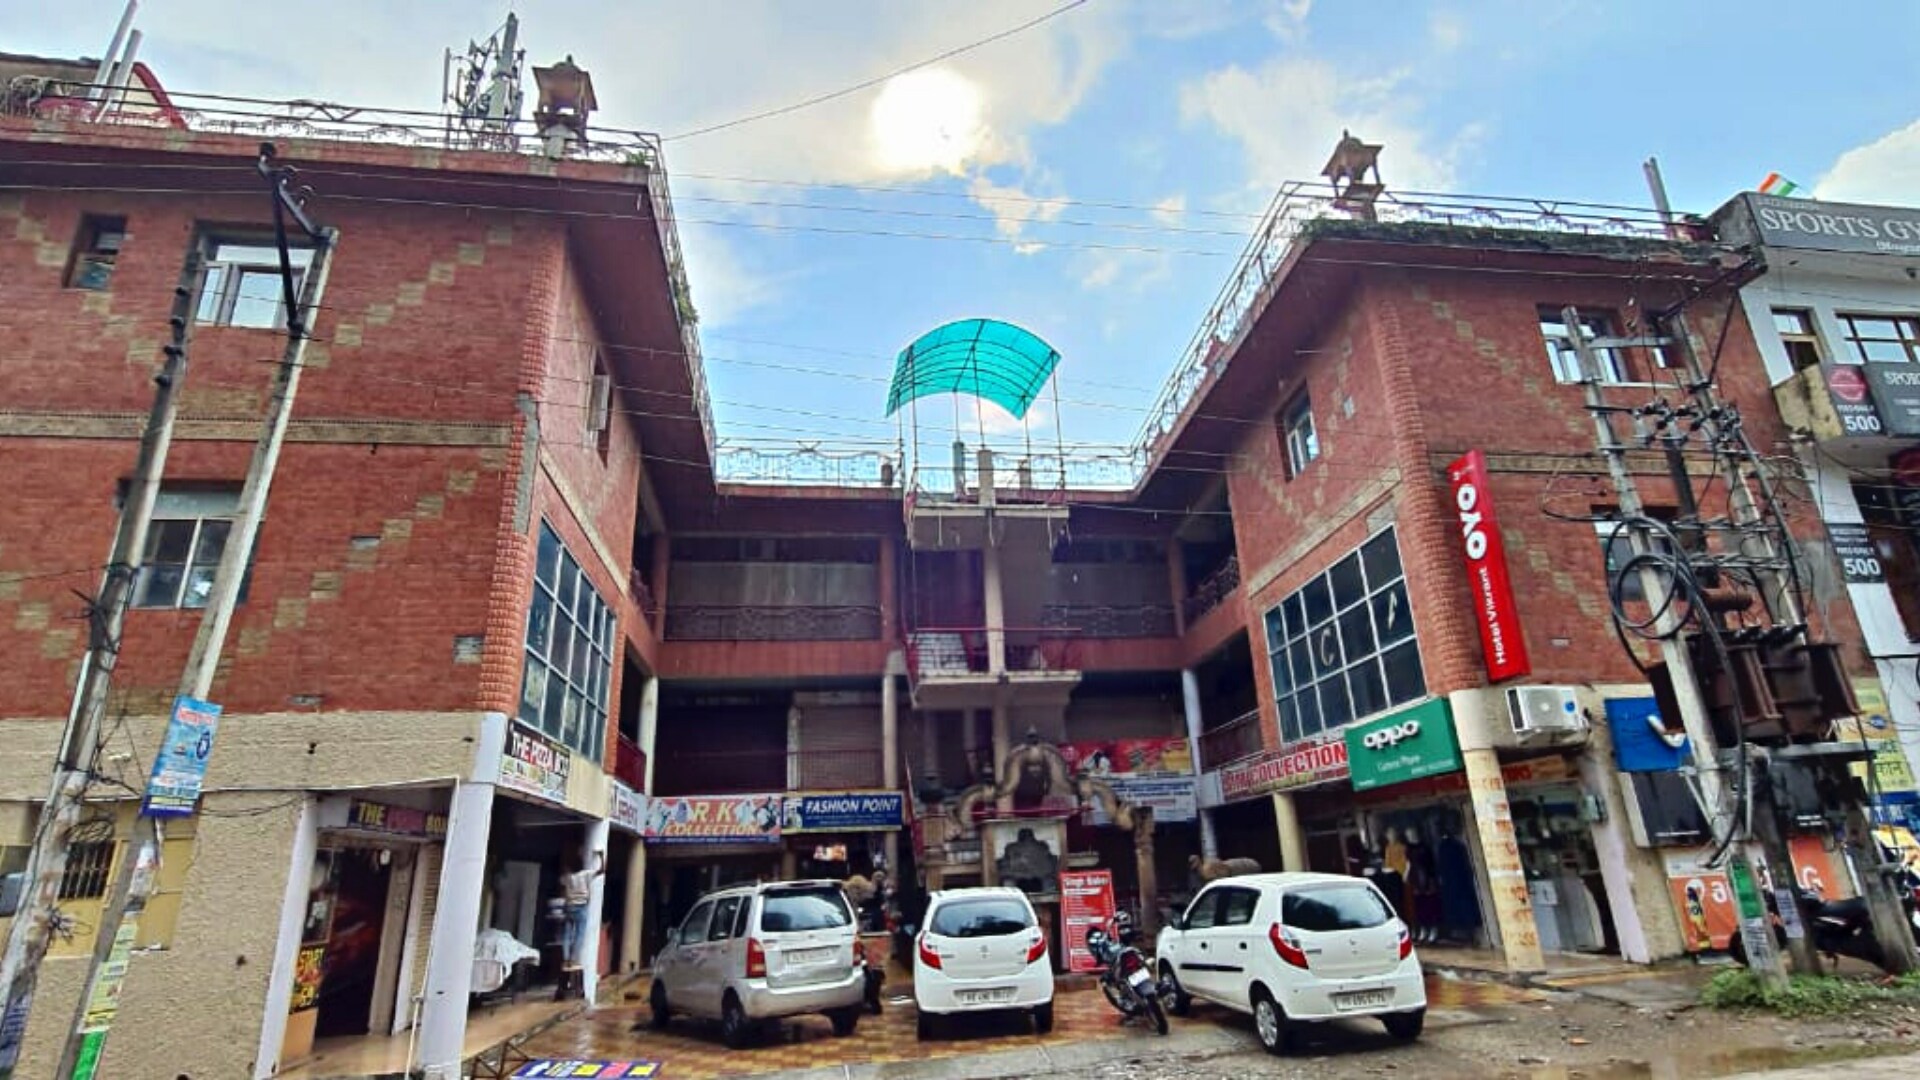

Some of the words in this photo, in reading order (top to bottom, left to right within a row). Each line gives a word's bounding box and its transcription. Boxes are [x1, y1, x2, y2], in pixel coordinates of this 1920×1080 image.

[1759, 207, 1880, 239] SPORTS
[1844, 415, 1881, 432] 500
[1457, 483, 1487, 560] OYO
[1843, 557, 1881, 577] 500
[1490, 620, 1507, 666] Hotel
[1363, 719, 1422, 750] oppo
[805, 798, 860, 814] FASHION
[861, 797, 899, 812] POINT
[664, 822, 757, 837] COLLECTION
